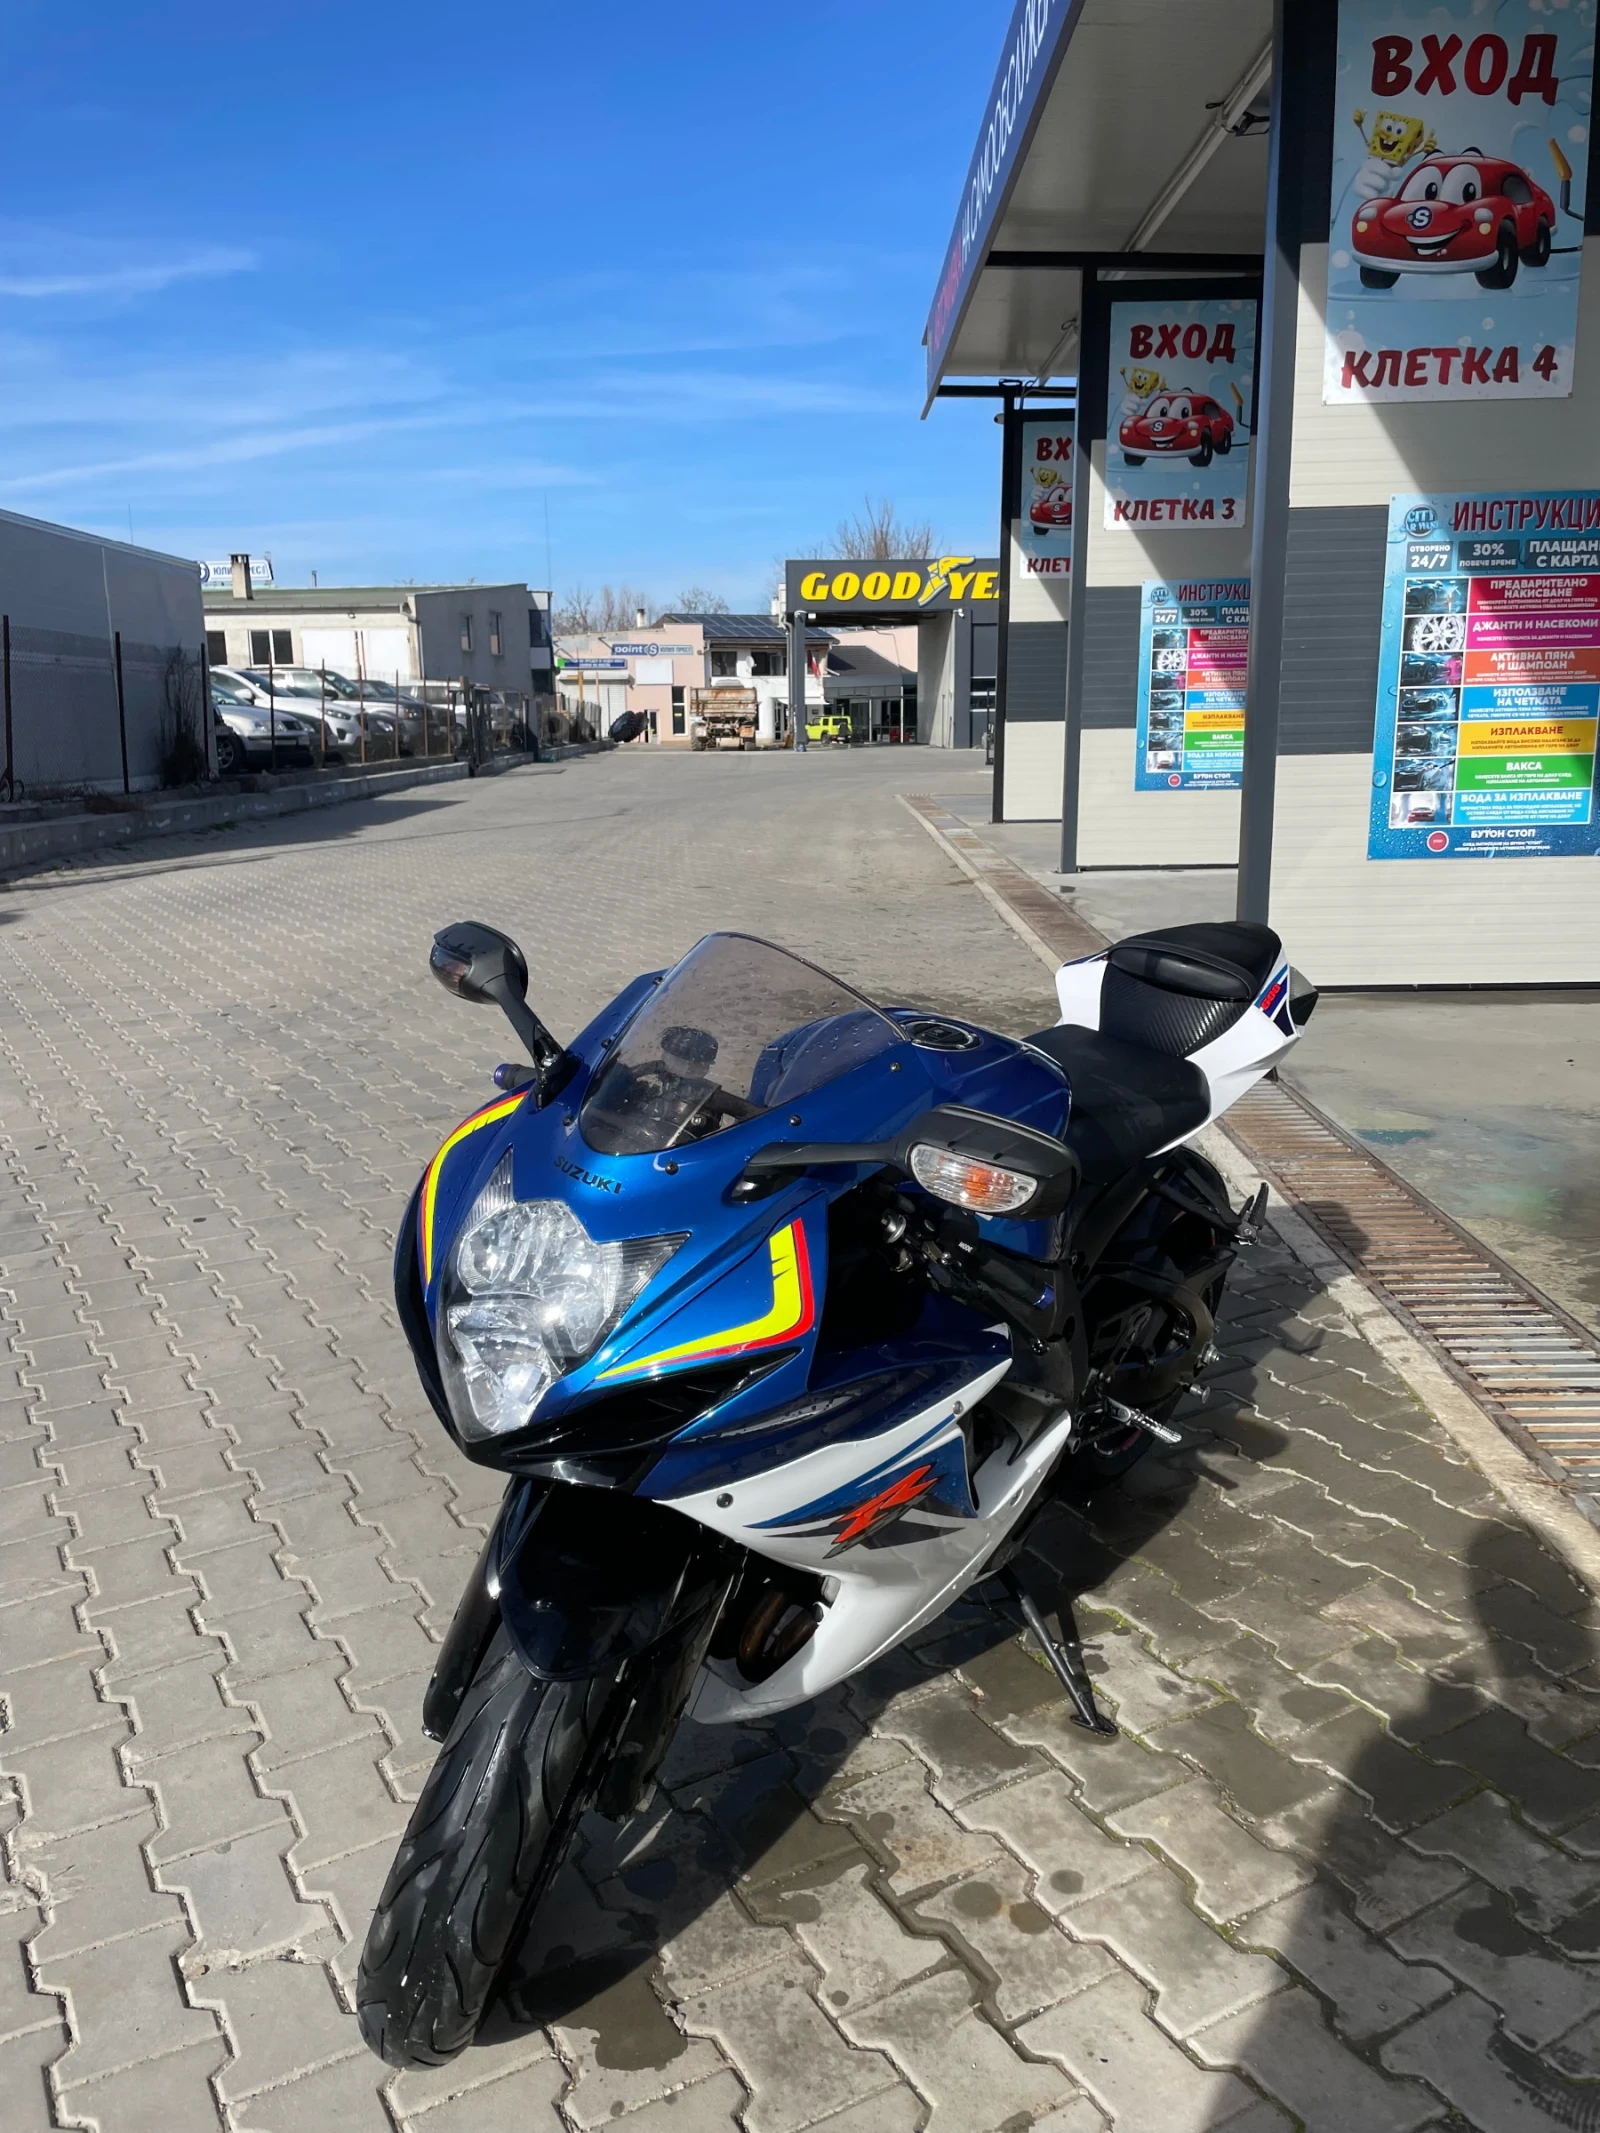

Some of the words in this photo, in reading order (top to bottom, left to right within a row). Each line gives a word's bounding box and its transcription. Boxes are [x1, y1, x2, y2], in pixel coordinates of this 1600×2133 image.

[1371, 33, 1559, 106] ВХОД
[1129, 324, 1236, 364] ВХОД
[1341, 345, 1520, 389] КЛЕТКА
[1532, 345, 1558, 381] 4
[1036, 436, 1072, 461] ВХ
[1113, 498, 1215, 522] КЛЕТКА
[1221, 498, 1236, 520] 3
[1409, 544, 1450, 553] ОТВОРЕНО
[1472, 543, 1505, 556] 30%
[1529, 539, 1600, 553] ПЛАЩАН
[1411, 554, 1448, 569] 24/7
[1459, 559, 1490, 567] ПОВЕЧЕ
[1491, 558, 1516, 566] ВРЕМЕ
[1536, 555, 1547, 567] С
[1550, 554, 1599, 567] КАРТА
[800, 570, 999, 601] GOODYE
[1490, 578, 1588, 590] ПРЕДВАРИТЕЛНО
[1504, 588, 1572, 598] НАКИСВАНЕ
[1189, 608, 1208, 616] 30%
[1155, 615, 1176, 623] 24/7
[1472, 621, 1522, 632] ДЖАНТИ
[1525, 620, 1533, 629] И
[1535, 618, 1598, 629] НАСЕКОМИ
[614, 645, 643, 655] point
[1490, 652, 1542, 662] АКТИВНА
[1545, 651, 1575, 660] ПЯНА
[1497, 662, 1505, 670] И
[1507, 660, 1567, 670] ШАМПОАН
[1493, 687, 1567, 697] ИЗПОЛЗВАНЕ
[1497, 698, 1512, 706] НА
[1514, 696, 1562, 706] ЧЕТКАТА
[1490, 726, 1564, 736] ИЗПЛАКВАНЕ
[1506, 761, 1542, 771] ВАКСА
[1461, 793, 1491, 803] ВОДА
[1494, 793, 1507, 801] ЗА
[1509, 791, 1583, 801] ИЗПЛАКВАНЕ
[1471, 829, 1506, 838] БУТОН
[1507, 829, 1536, 838] СТОП
[1261, 983, 1281, 1010] 600
[554, 1155, 622, 1195] SUZUKI
[958, 1241, 973, 1253] MODE
